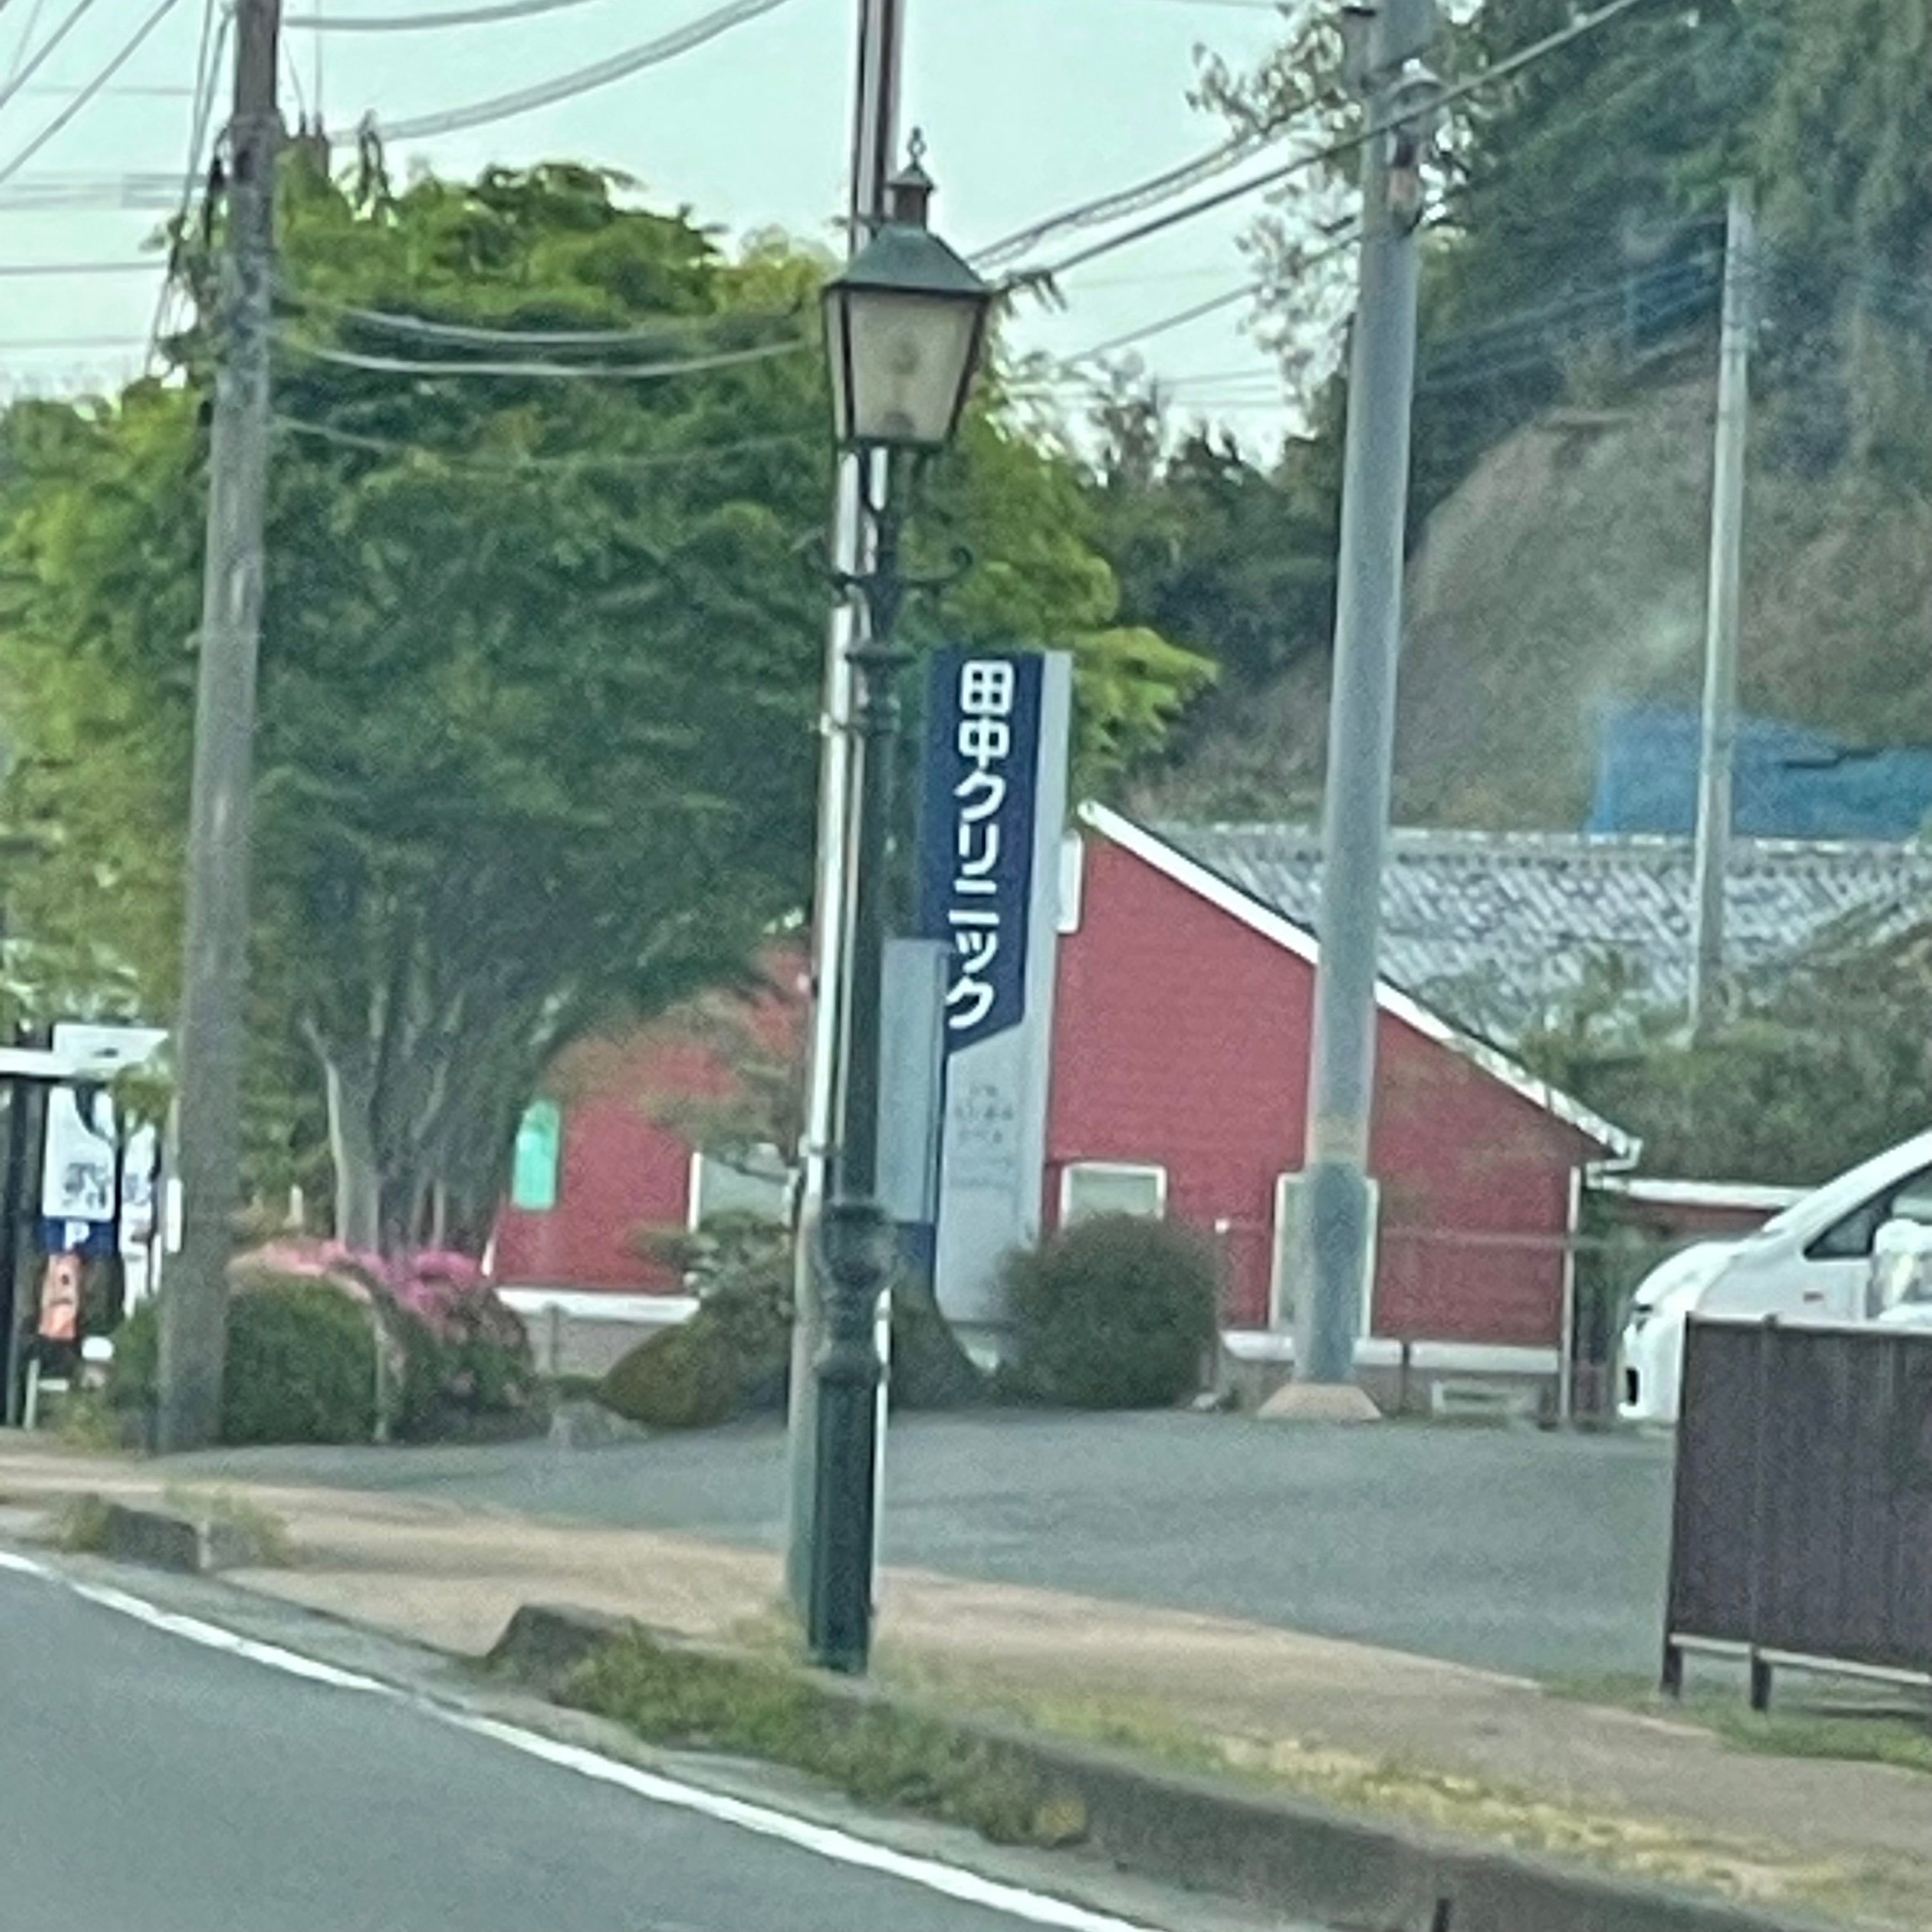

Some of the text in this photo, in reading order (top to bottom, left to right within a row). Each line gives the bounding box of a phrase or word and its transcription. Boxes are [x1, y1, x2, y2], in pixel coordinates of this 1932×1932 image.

[946, 661, 1014, 1029] 田中クリニック
